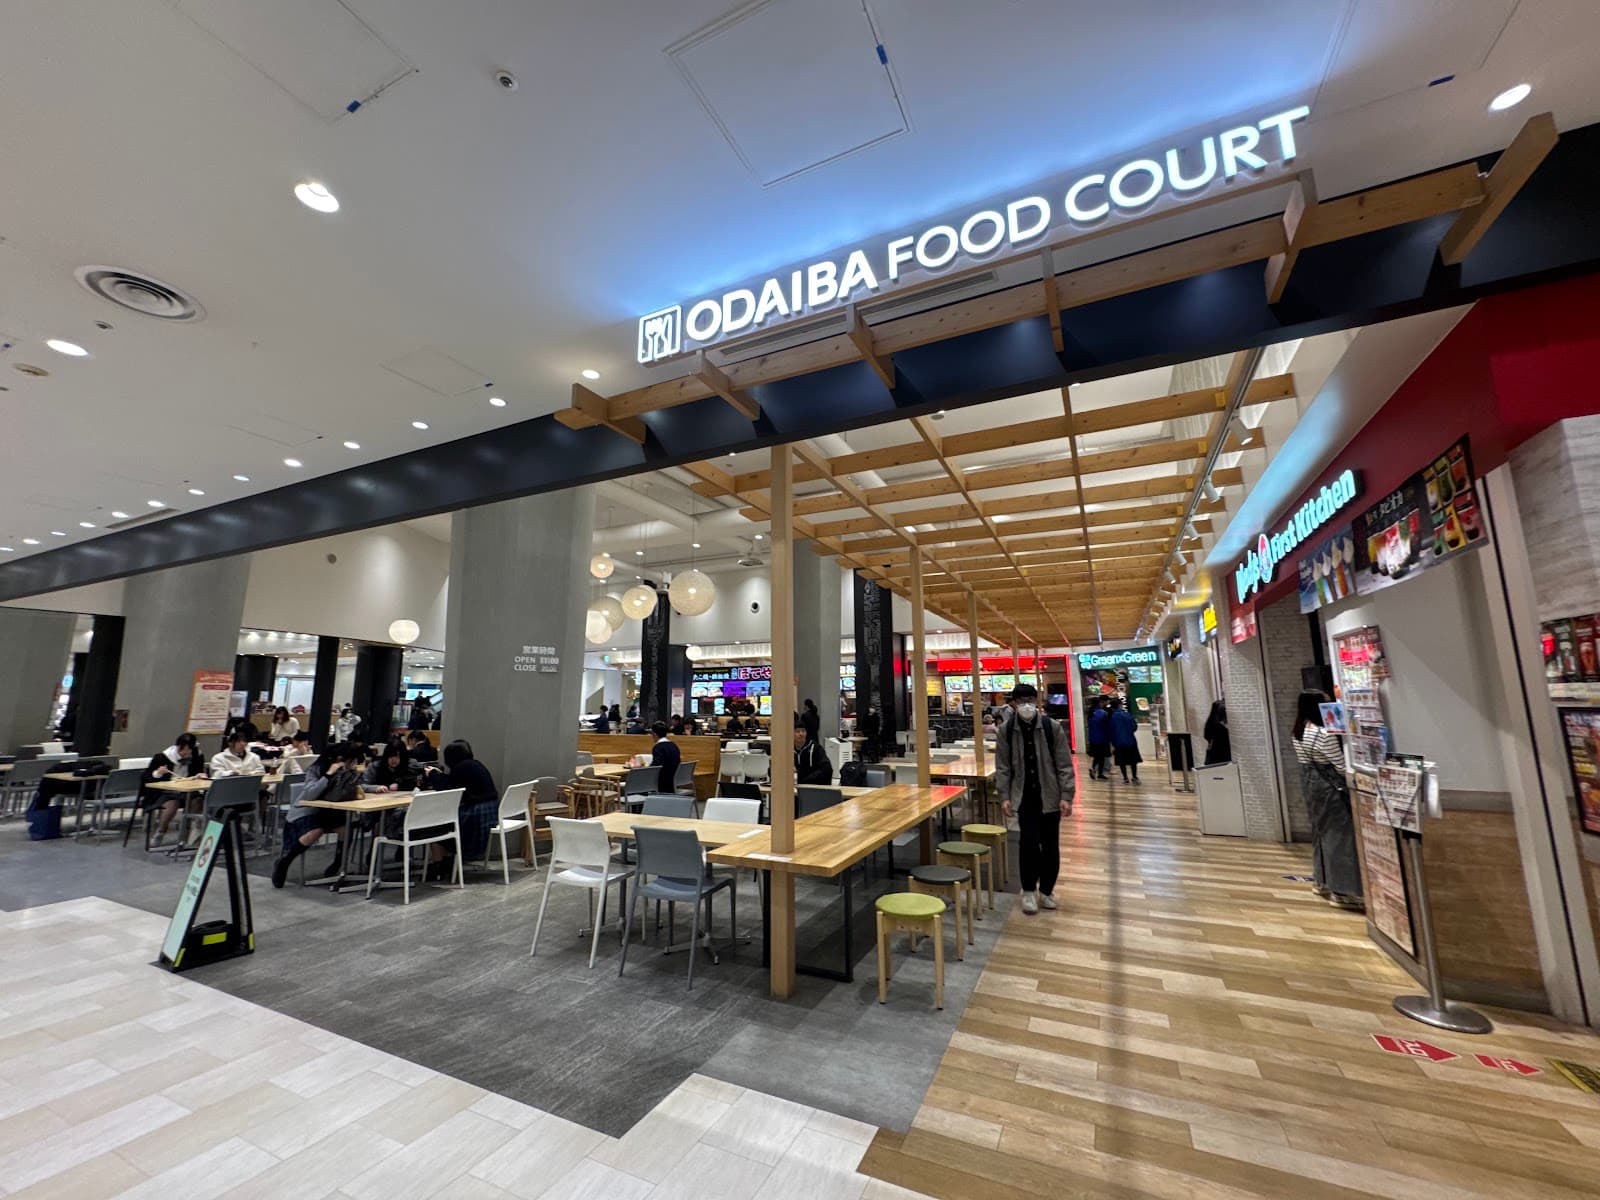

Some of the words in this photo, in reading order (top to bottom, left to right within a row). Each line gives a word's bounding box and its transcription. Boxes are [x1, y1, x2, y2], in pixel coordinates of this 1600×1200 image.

[686, 250, 879, 341] ODAIBA
[887, 196, 1051, 281] FOOD
[1064, 105, 1310, 222] COURT
[1270, 519, 1298, 564] First
[1294, 469, 1356, 542] Kitchen
[514, 656, 536, 664] OPEN
